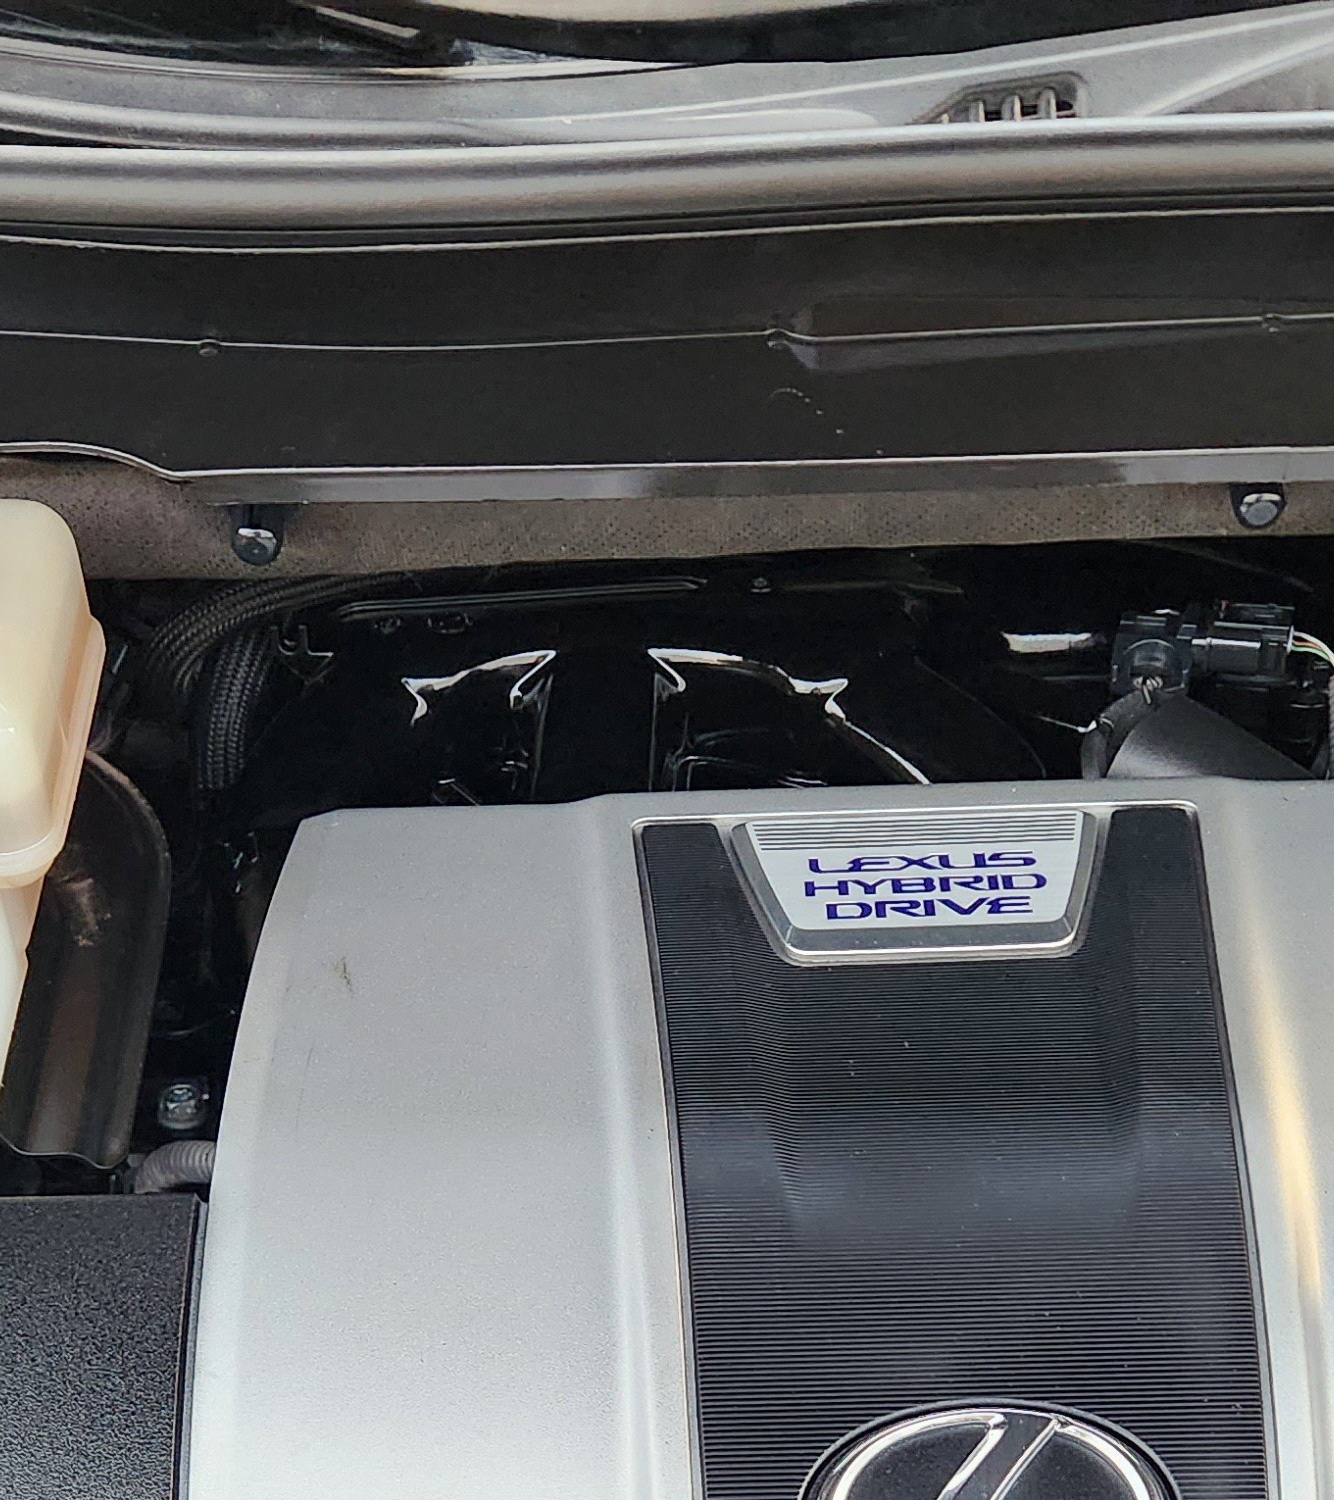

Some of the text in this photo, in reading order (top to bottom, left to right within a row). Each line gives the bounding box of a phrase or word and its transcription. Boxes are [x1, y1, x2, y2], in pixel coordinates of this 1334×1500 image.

[808, 851, 1037, 874] LEXUS
[804, 873, 1048, 897] HYBRID
[826, 896, 1034, 920] DRIVE
